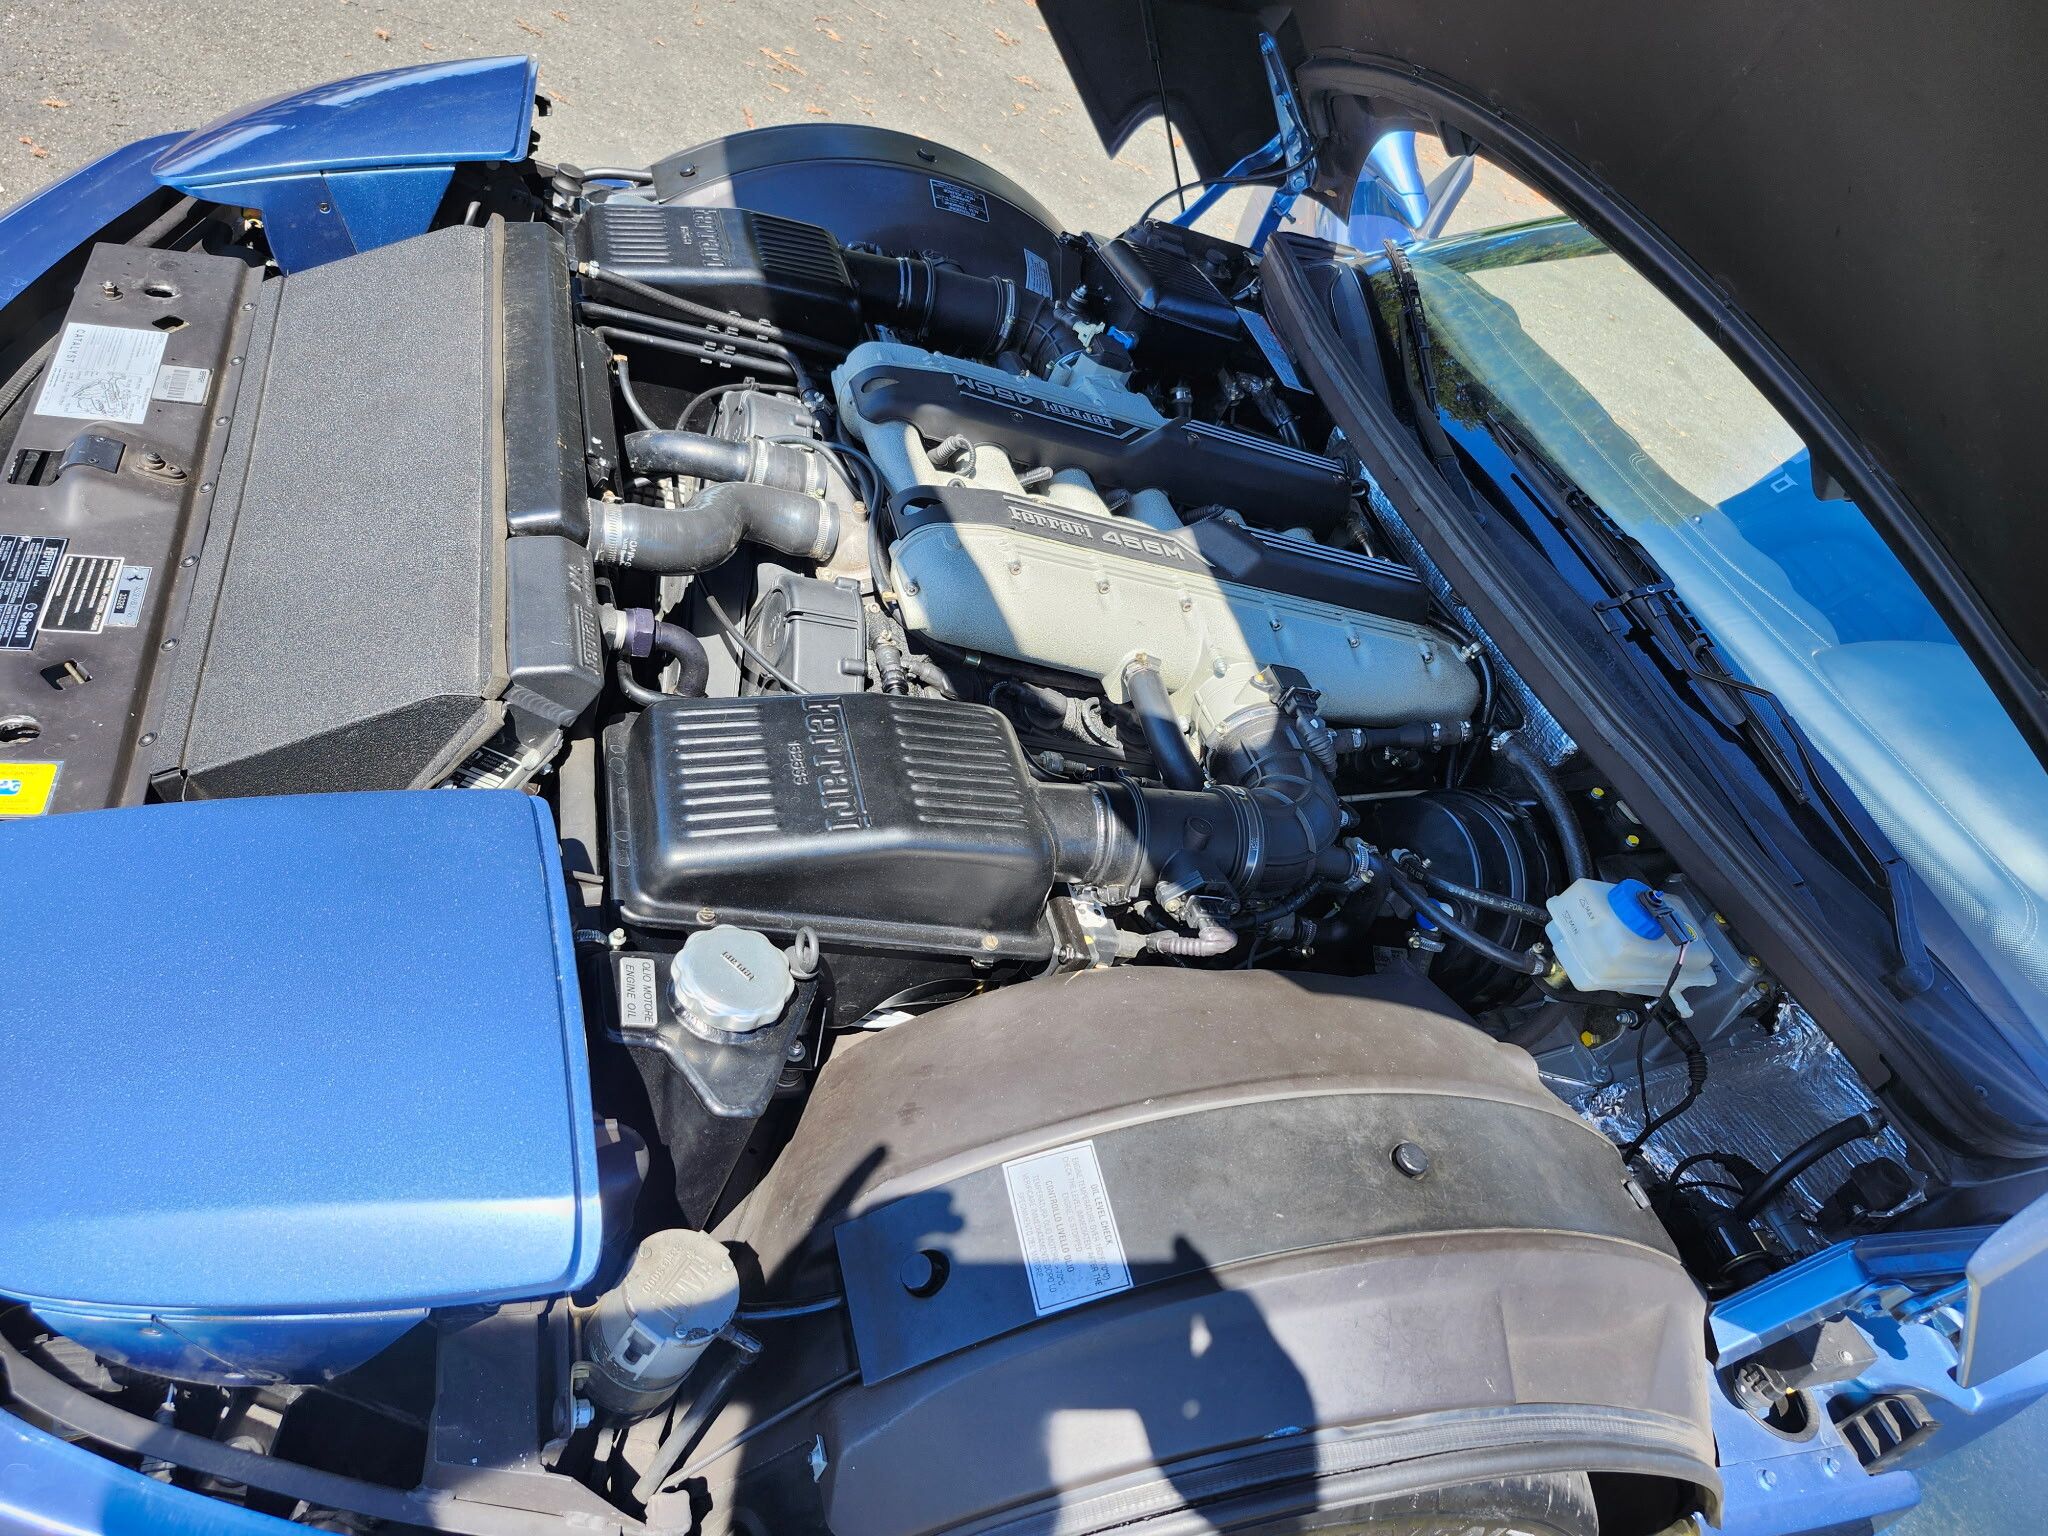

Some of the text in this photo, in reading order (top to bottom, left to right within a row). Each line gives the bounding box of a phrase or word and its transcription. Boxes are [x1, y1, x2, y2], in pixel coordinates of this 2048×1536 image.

[64, 328, 86, 363] CATALYST
[953, 374, 1034, 405] 456M
[1102, 531, 1185, 561] 456M
[15, 611, 34, 638] Shell
[801, 697, 870, 831] Ferrari
[624, 964, 637, 1018] ENGINE OIL
[641, 962, 654, 1022] OLIO MOTORE
[1045, 1179, 1074, 1273] CONTROLLO LIVELLO OLIO
[1090, 1183, 1114, 1246] OIL LEVEL CHECK
[1093, 1272, 1102, 1287] THE
